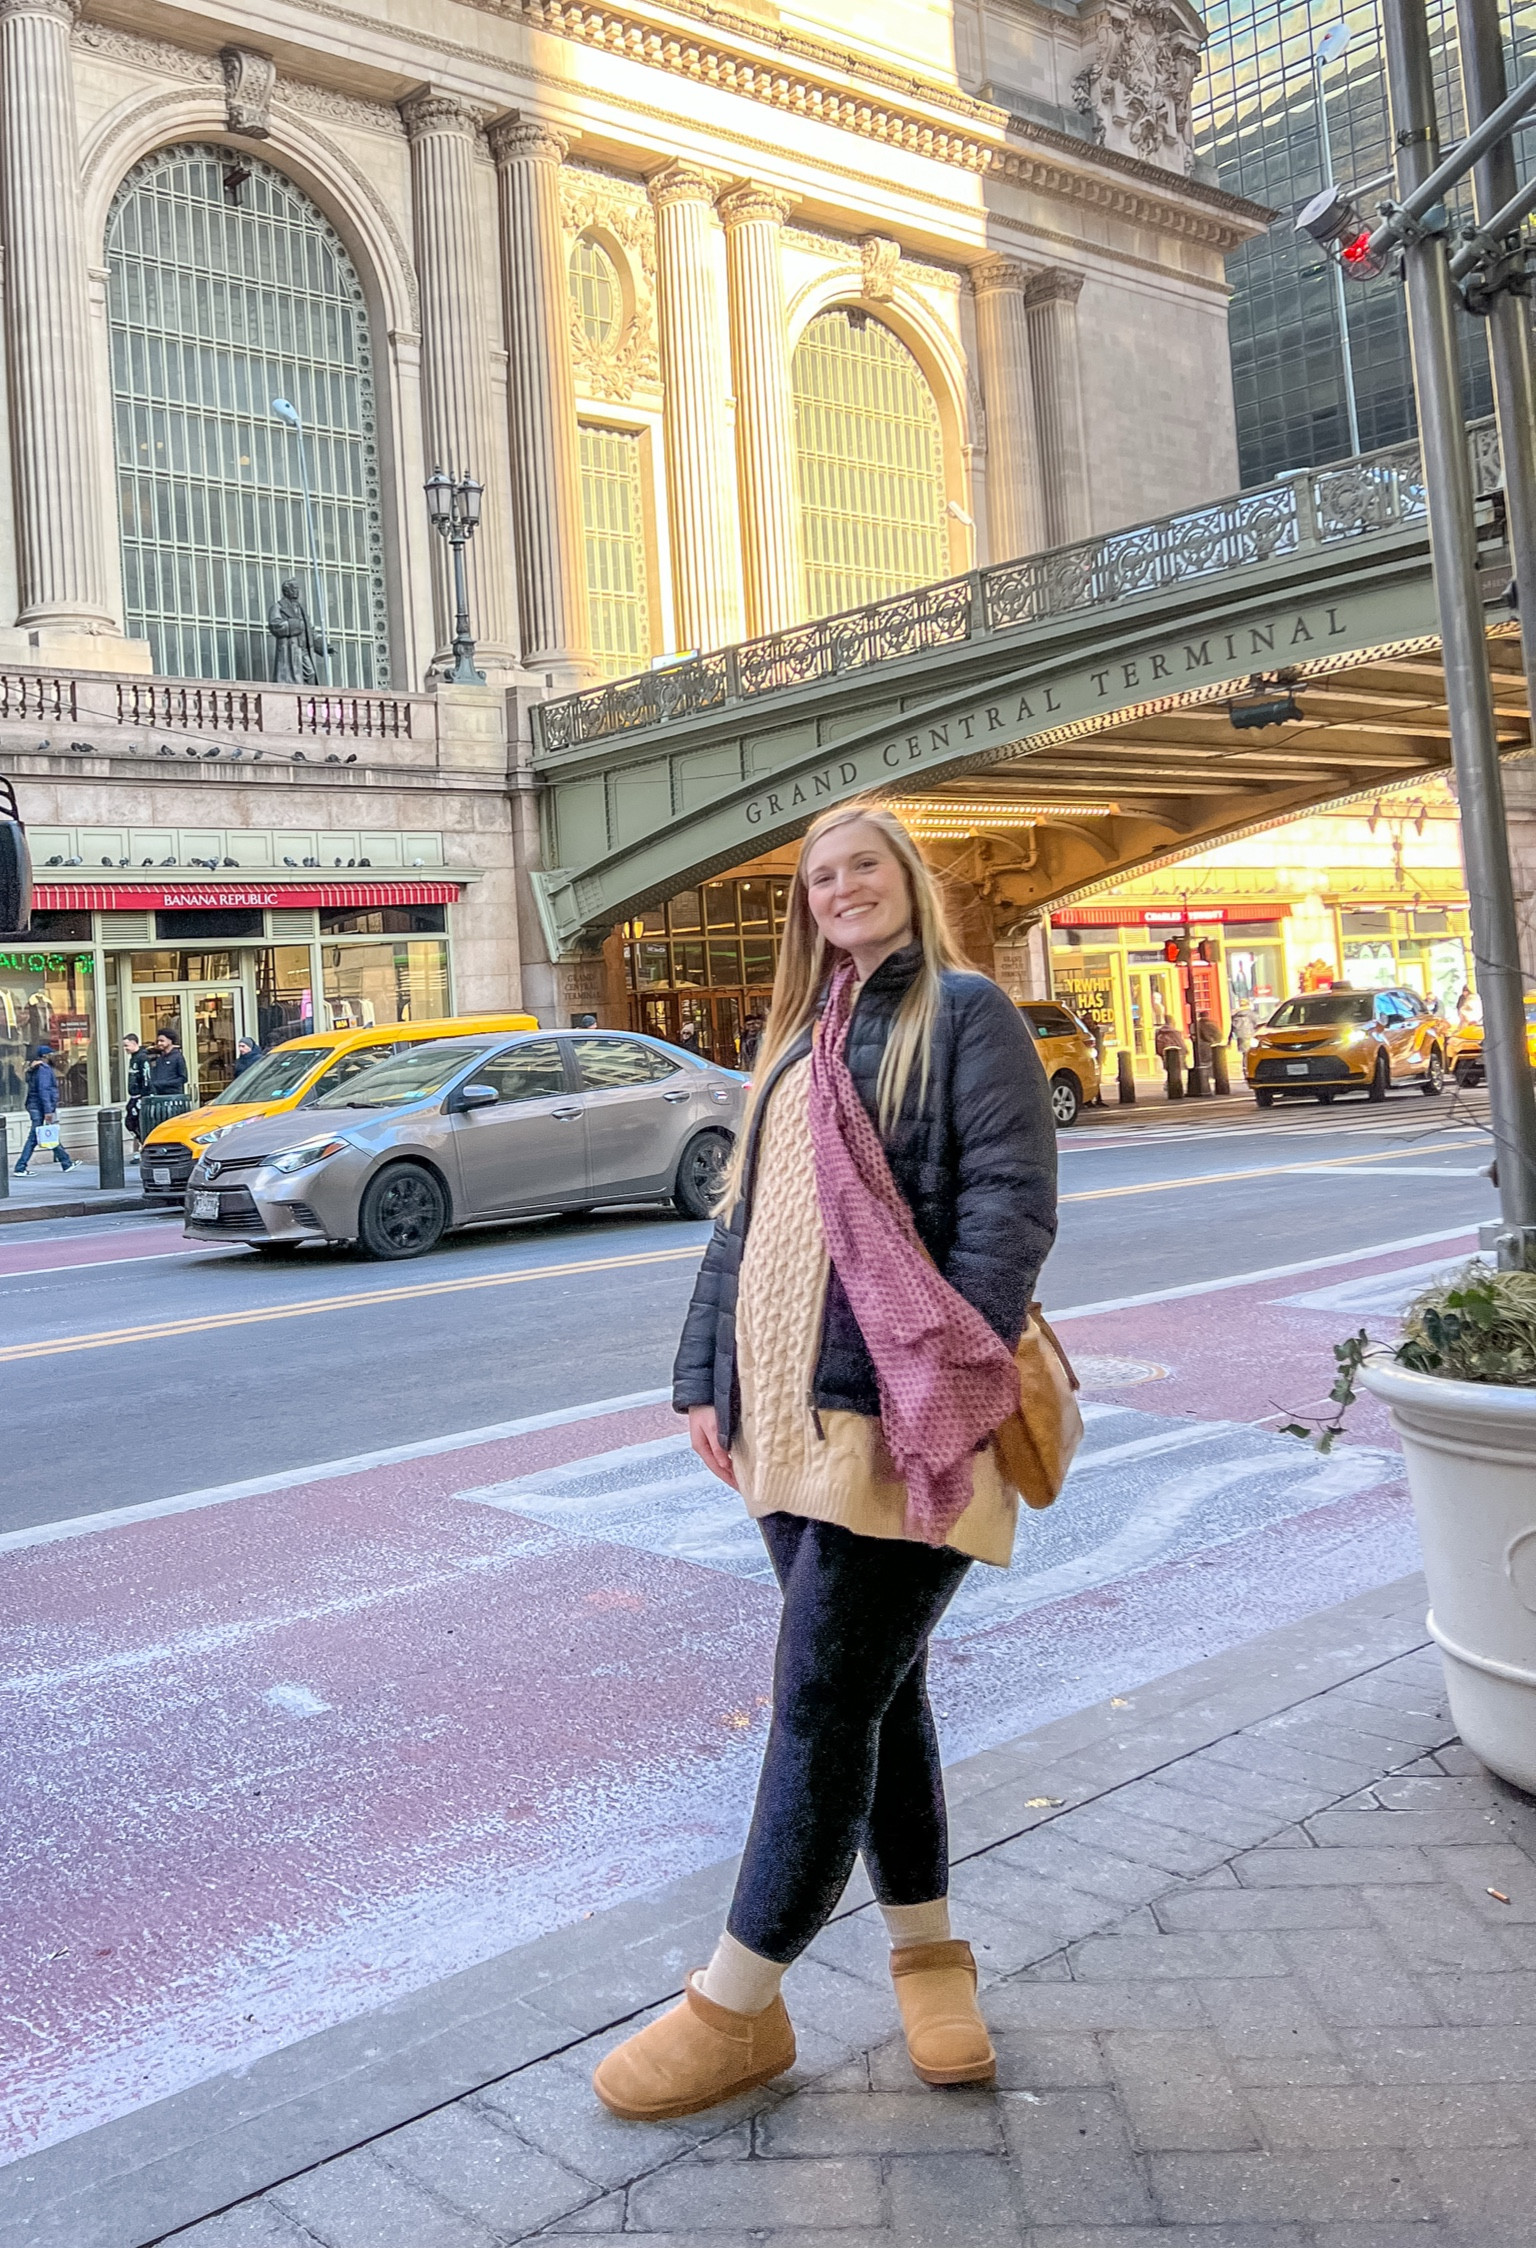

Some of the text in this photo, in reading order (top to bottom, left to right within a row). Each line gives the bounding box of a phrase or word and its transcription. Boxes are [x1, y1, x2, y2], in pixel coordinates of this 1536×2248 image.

[746, 608, 1346, 824] GRAND CENTRAL TERMINAL
[164, 893, 278, 906] BANANA REPUBLIC
[1078, 993, 1104, 1008] HAS
